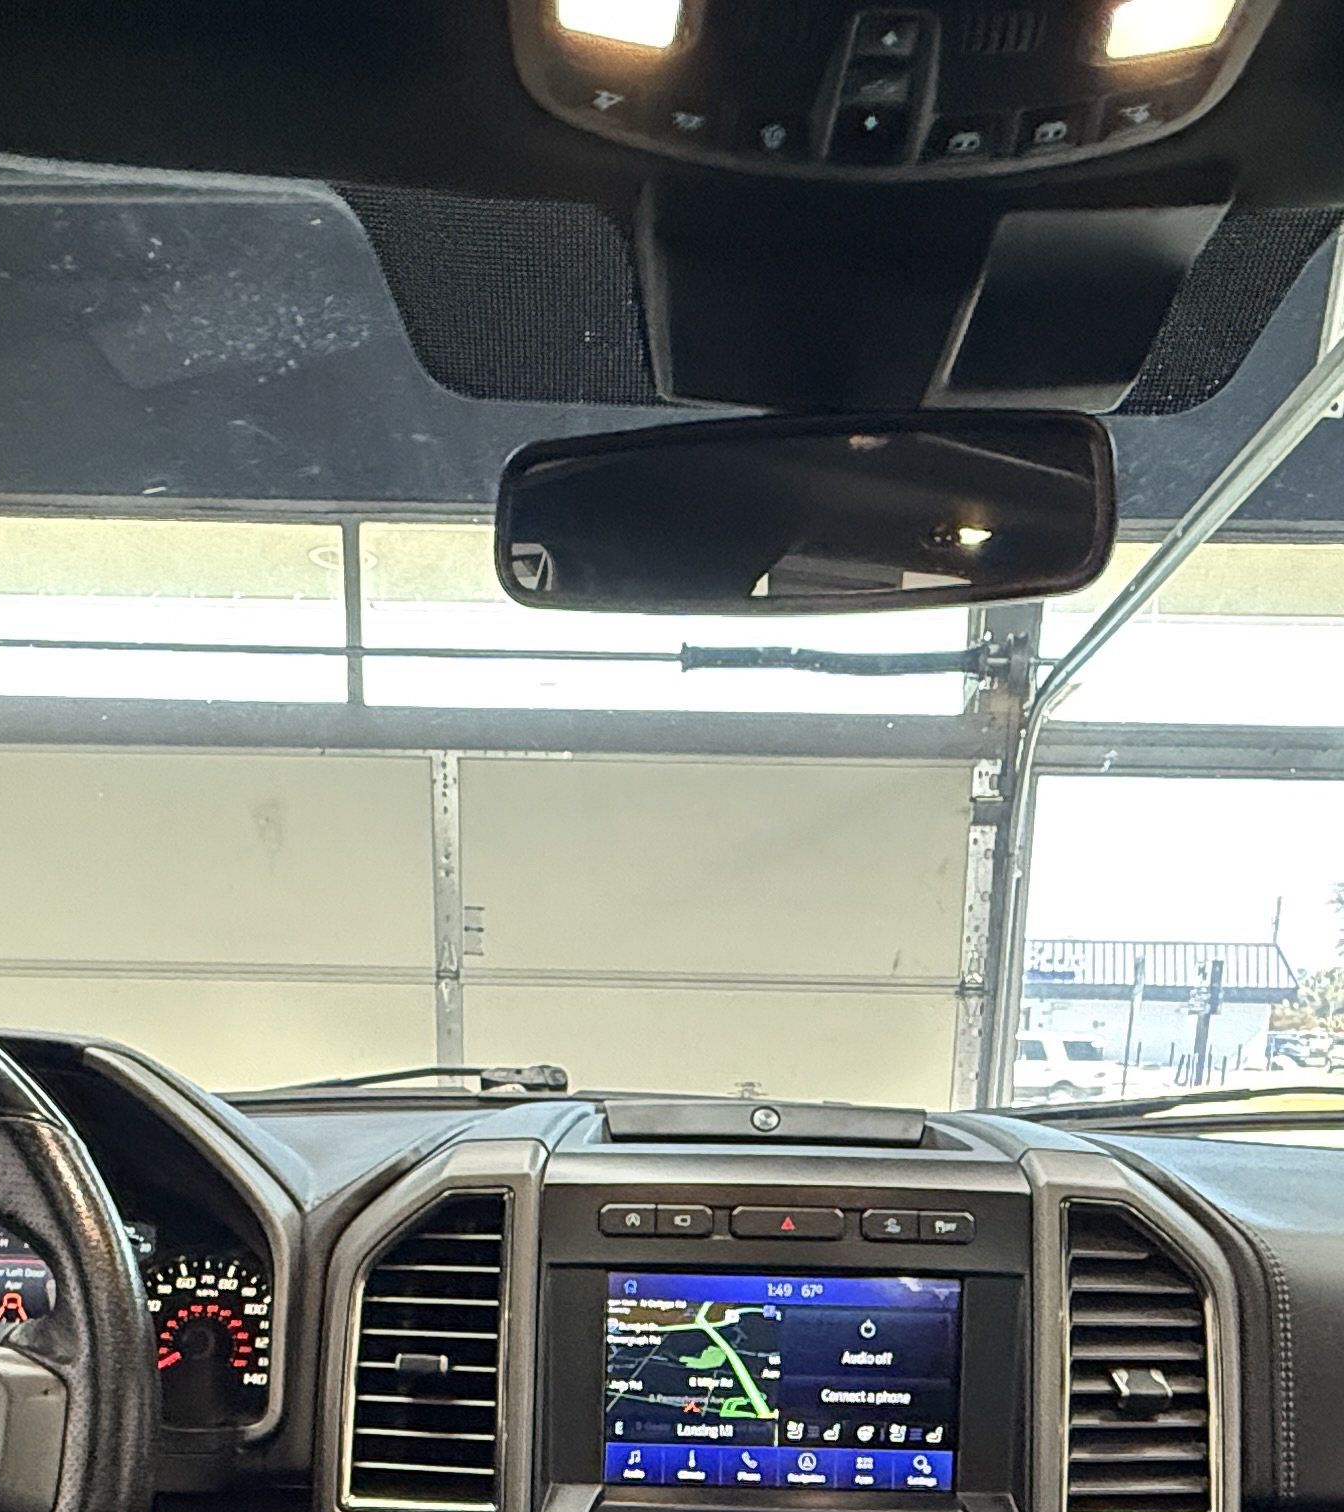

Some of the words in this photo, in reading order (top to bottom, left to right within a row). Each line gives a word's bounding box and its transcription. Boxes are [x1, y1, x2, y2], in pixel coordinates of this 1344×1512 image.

[6, 1267, 23, 1277] Left
[176, 1277, 196, 1289] 60
[217, 1278, 238, 1290] 80
[767, 1283, 793, 1297] 1:49
[841, 1351, 875, 1365] Audio
[875, 1352, 893, 1365] off
[821, 1389, 866, 1404] Connect
[866, 1393, 875, 1403] a
[875, 1390, 912, 1406] phone
[677, 1423, 718, 1439] Lansing
